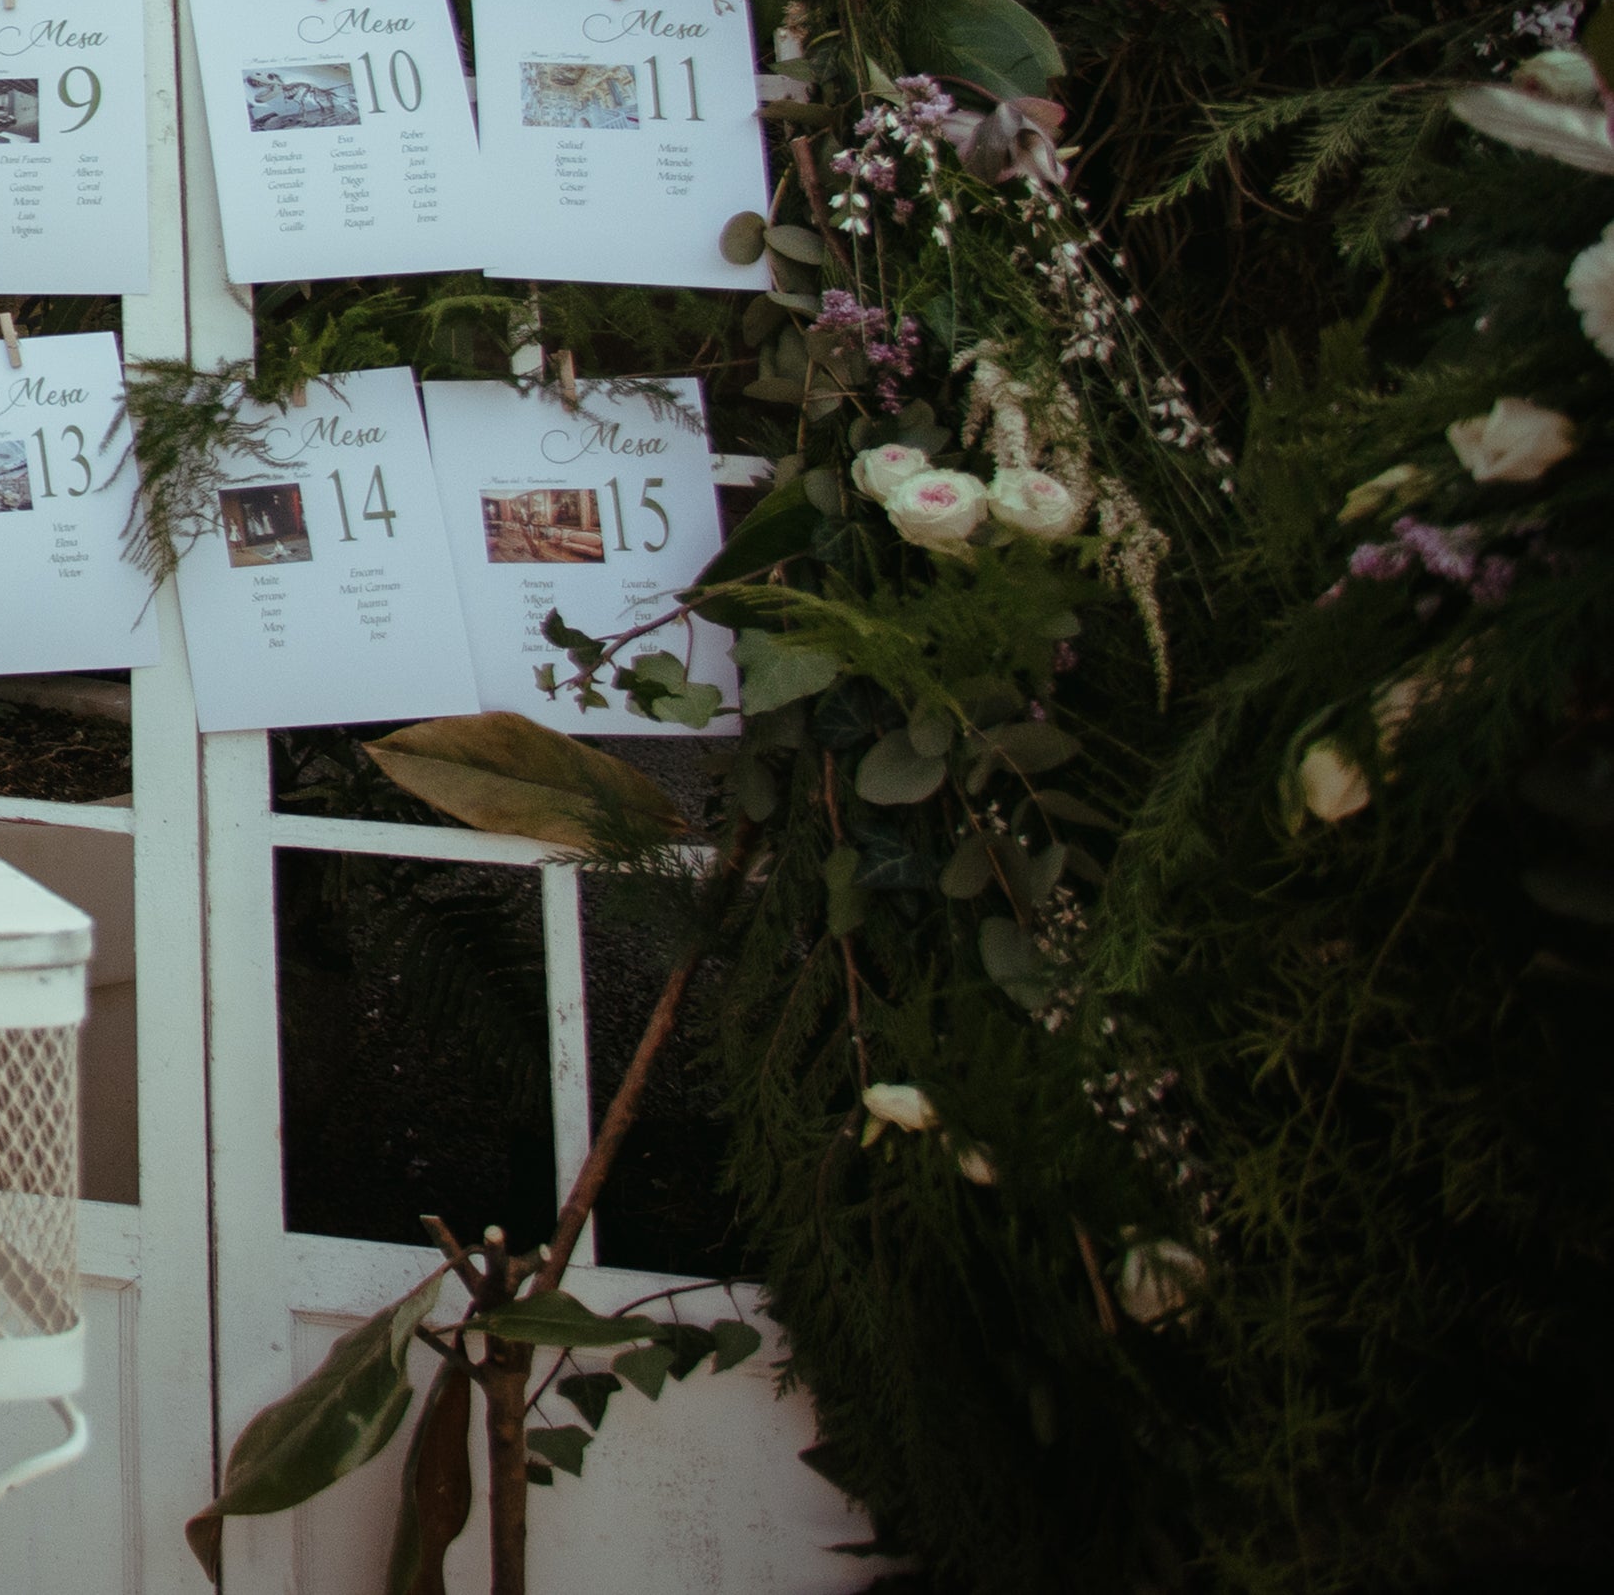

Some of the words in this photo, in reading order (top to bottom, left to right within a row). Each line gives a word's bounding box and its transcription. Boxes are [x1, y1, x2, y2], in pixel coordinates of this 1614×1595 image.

[297, 8, 415, 43] Mesa
[582, 9, 708, 43] Mesa
[358, 49, 422, 114] 10
[643, 55, 705, 122] 11
[57, 65, 102, 133] 9
[338, 135, 354, 144] Eva
[330, 147, 367, 158] Gonzalo
[401, 145, 429, 153] Diana
[261, 153, 303, 163] Alejandra
[74, 169, 104, 177] Alberto
[262, 167, 306, 176] Almudena
[404, 172, 437, 181] Sandra
[268, 181, 305, 190] Gonzalo
[341, 176, 365, 187] Diego
[408, 185, 437, 195] Carlos
[77, 196, 103, 205] David
[346, 205, 369, 213] Elena
[344, 217, 376, 229] Raquel
[417, 214, 439, 223] Irene
[264, 416, 386, 461] Mesa
[541, 422, 668, 464] Mesa
[31, 425, 92, 497] 13
[327, 465, 397, 542] 14
[605, 477, 669, 553] 15
[55, 539, 79, 547] Elena
[49, 552, 90, 564] Alejandra
[366, 582, 401, 592] Carmen
[622, 579, 658, 588] Lourdes
[261, 608, 283, 619] Juan
[360, 613, 392, 626] Raquel
